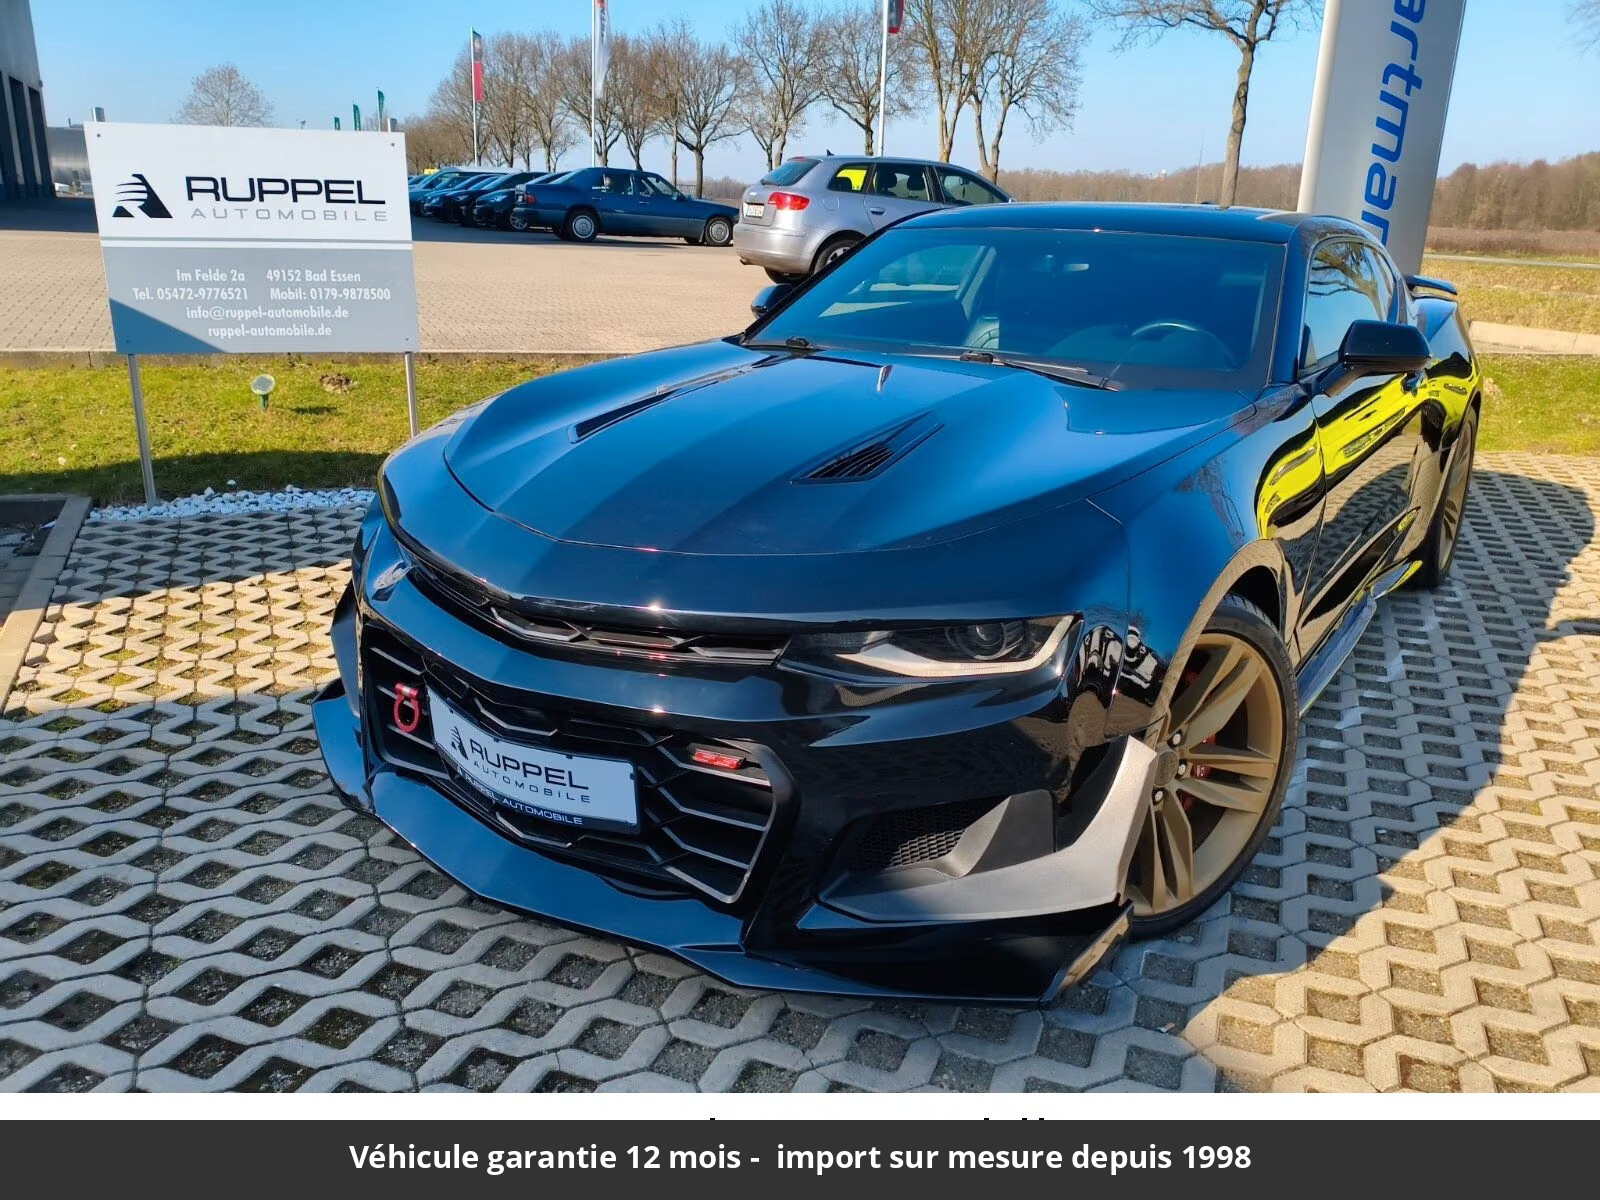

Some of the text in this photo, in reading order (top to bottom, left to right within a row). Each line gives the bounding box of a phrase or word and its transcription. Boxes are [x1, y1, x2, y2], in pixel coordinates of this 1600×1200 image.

[185, 176, 386, 205] RUPPEL
[190, 208, 388, 222] AUTOMOBILE
[176, 268, 361, 283] Im Felde 2a 49152 Bad Essen
[133, 287, 391, 301] Tel. 05472-9776521 Mobil: 0179-9878500
[186, 305, 349, 322] info@ruppel-automobile.de
[208, 323, 332, 340] ruppel-automobile.de
[470, 738, 590, 791] RUPPEL
[473, 760, 591, 803] AUTOMOBILE
[502, 798, 583, 825] AUTOMOBILE
